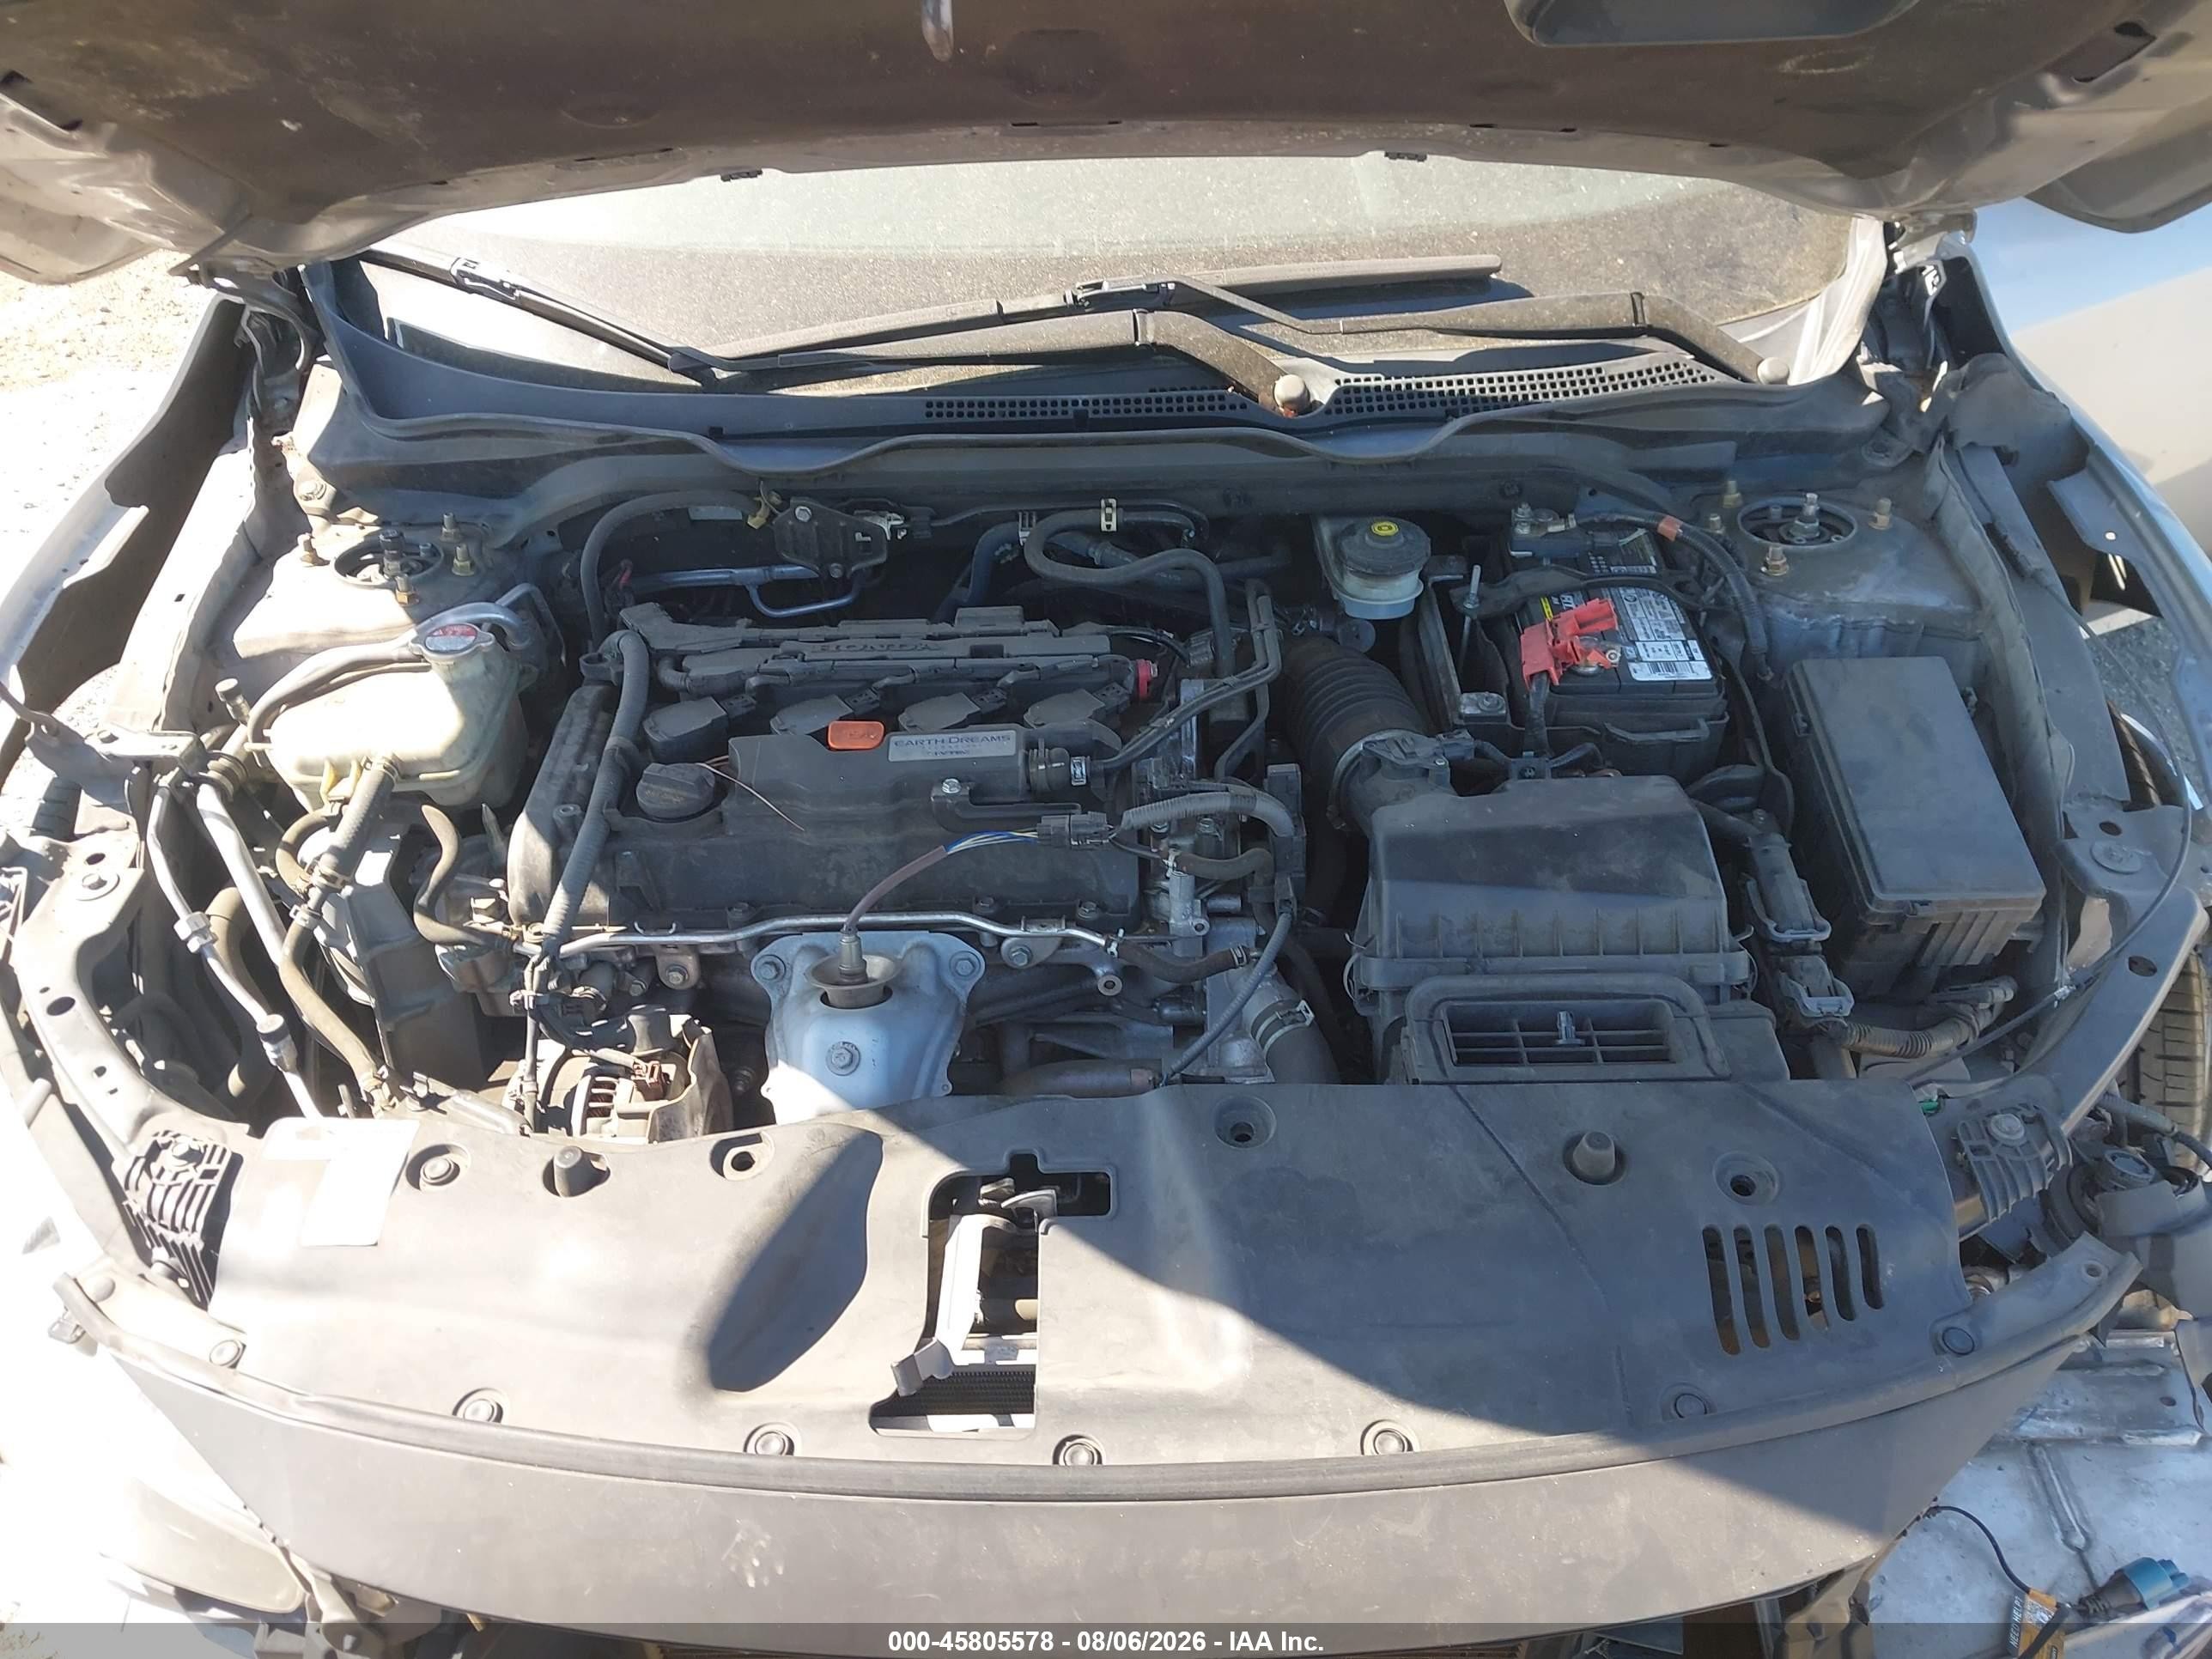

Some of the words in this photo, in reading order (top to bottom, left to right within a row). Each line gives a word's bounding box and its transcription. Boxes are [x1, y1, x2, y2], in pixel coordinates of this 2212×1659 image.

[894, 738, 945, 747] EARTH
[947, 734, 1012, 744] DREAMS
[2008, 1623, 2020, 1649] NEED
